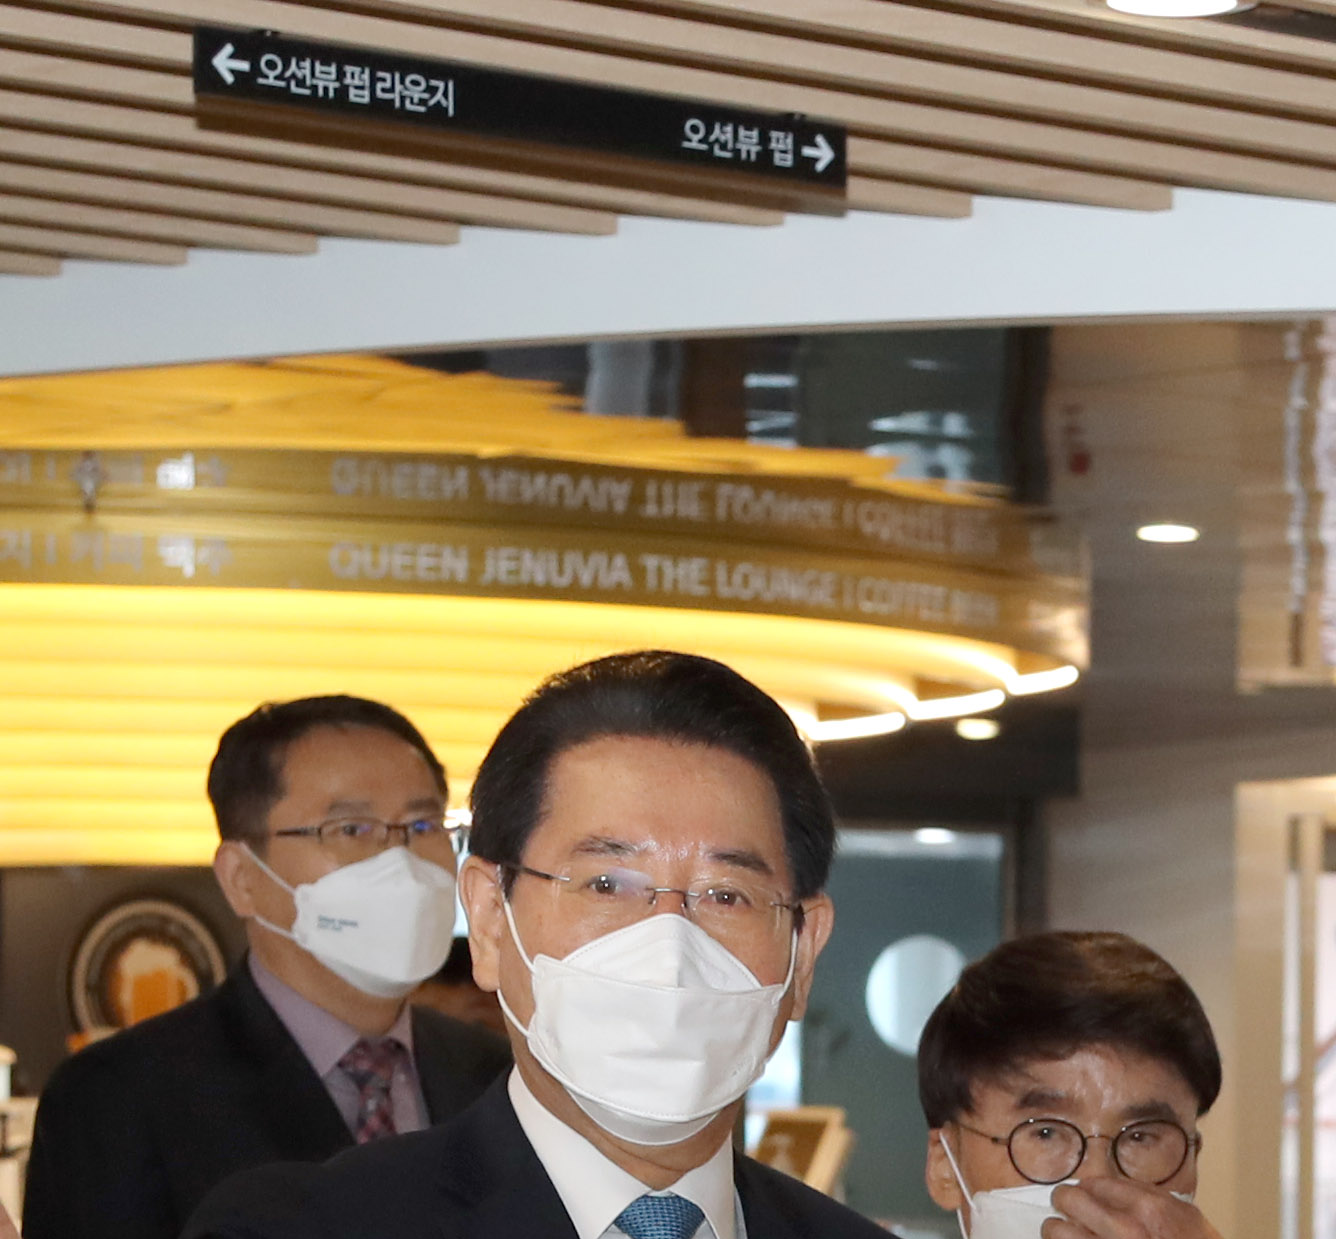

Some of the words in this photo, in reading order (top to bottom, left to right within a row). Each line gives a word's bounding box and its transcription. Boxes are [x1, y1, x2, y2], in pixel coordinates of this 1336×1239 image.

[256, 53, 340, 99] 오션뷰
[343, 64, 370, 104] 펍
[375, 71, 455, 117] 라운지
[681, 117, 762, 162] 오션뷰
[768, 130, 794, 168] 펍
[329, 541, 469, 582] QUEEN
[479, 547, 632, 590] JENUVIA
[640, 555, 709, 596] THE
[716, 560, 836, 607] LOUNGE
